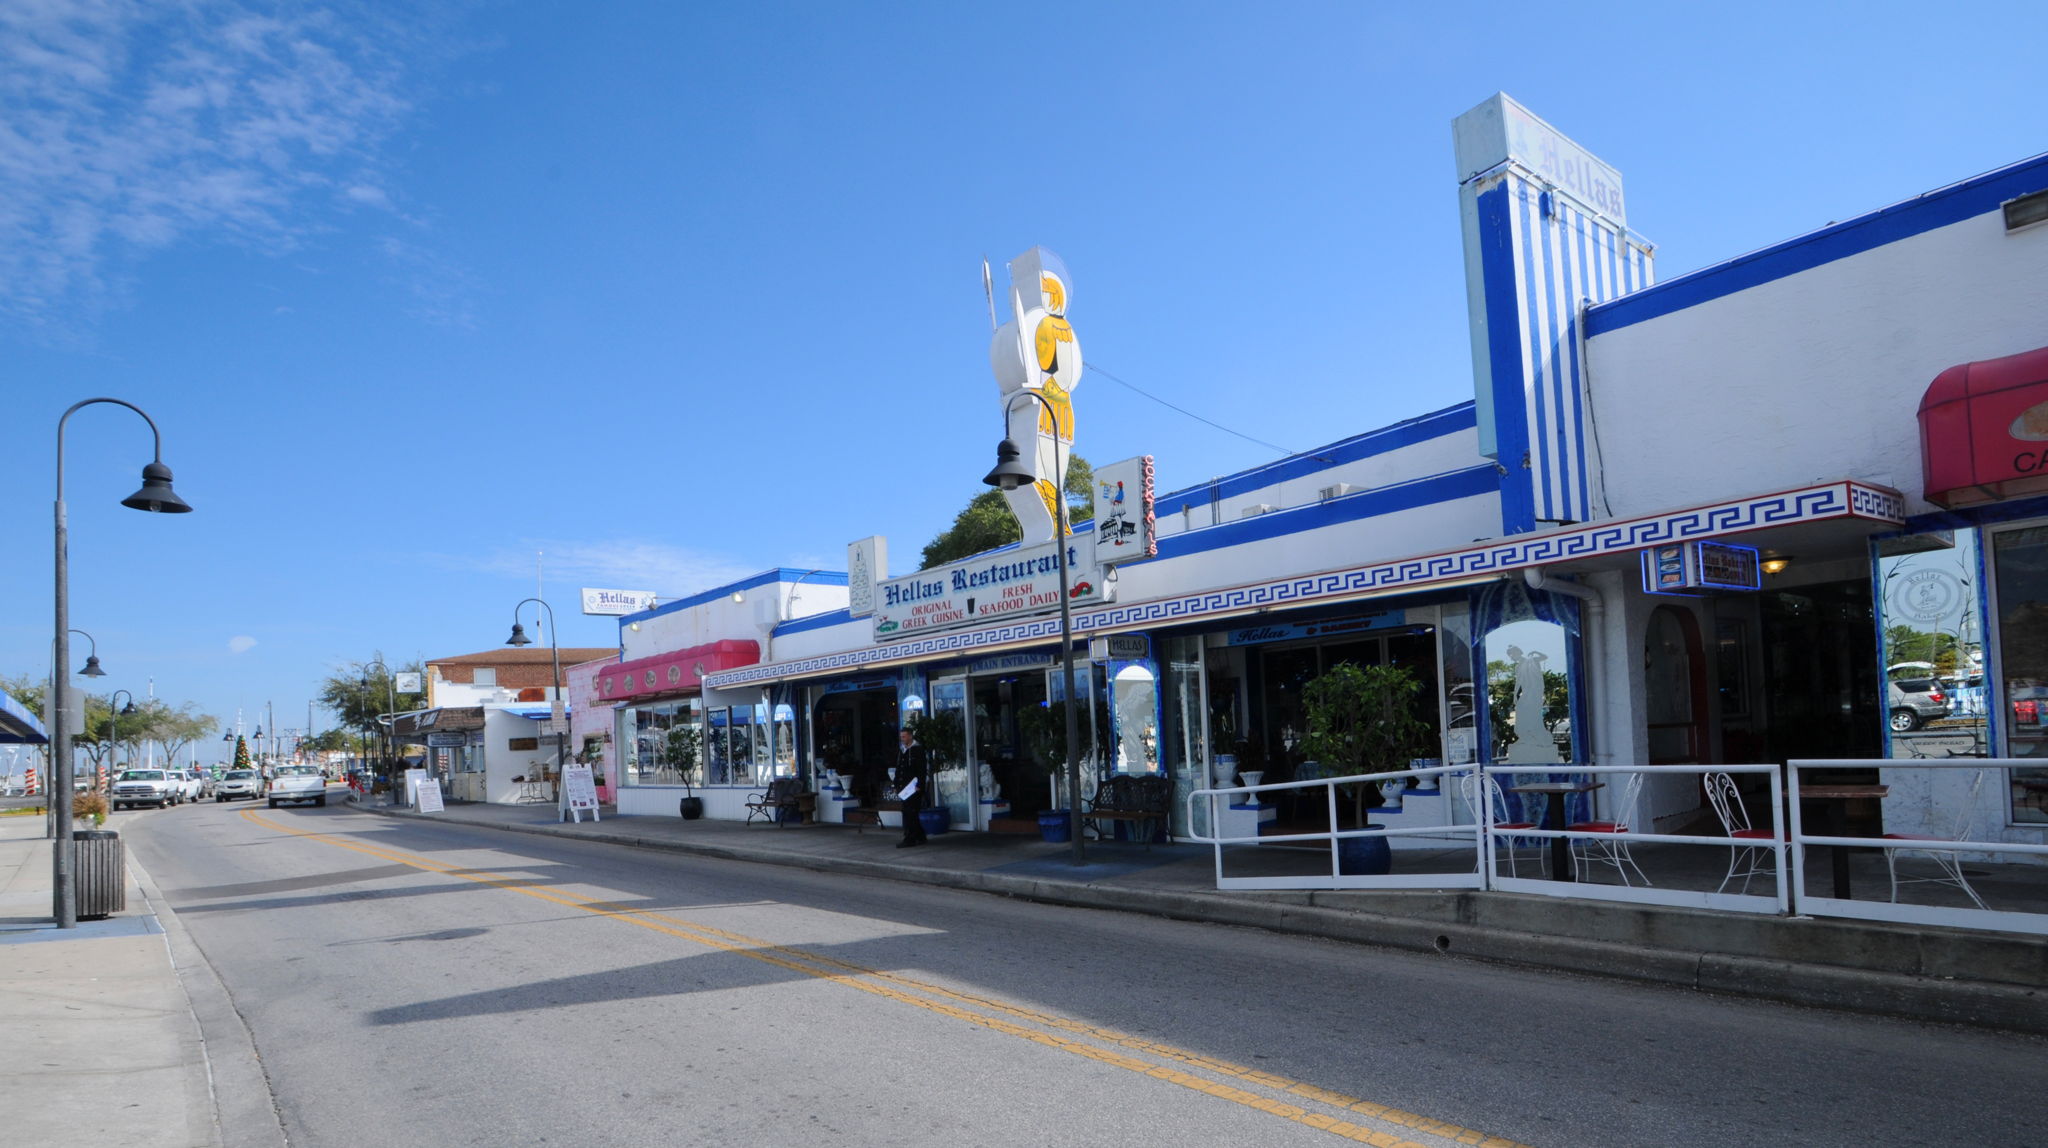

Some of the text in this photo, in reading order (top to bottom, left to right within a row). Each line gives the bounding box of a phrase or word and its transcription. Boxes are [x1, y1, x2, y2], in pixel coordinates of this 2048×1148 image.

[1539, 136, 1623, 217] Hellas
[1144, 454, 1158, 556] COCKTAILS
[1906, 571, 1942, 585] Hellas
[598, 591, 636, 605] Hellas
[884, 580, 944, 606] Hellas
[1002, 583, 1034, 599] FRESH
[911, 600, 953, 616] ORIGINAL
[979, 590, 1060, 616] SEAFOOD DAILY
[902, 609, 965, 630] GREEK CUISINE
[1112, 639, 1143, 651] HELLAS
